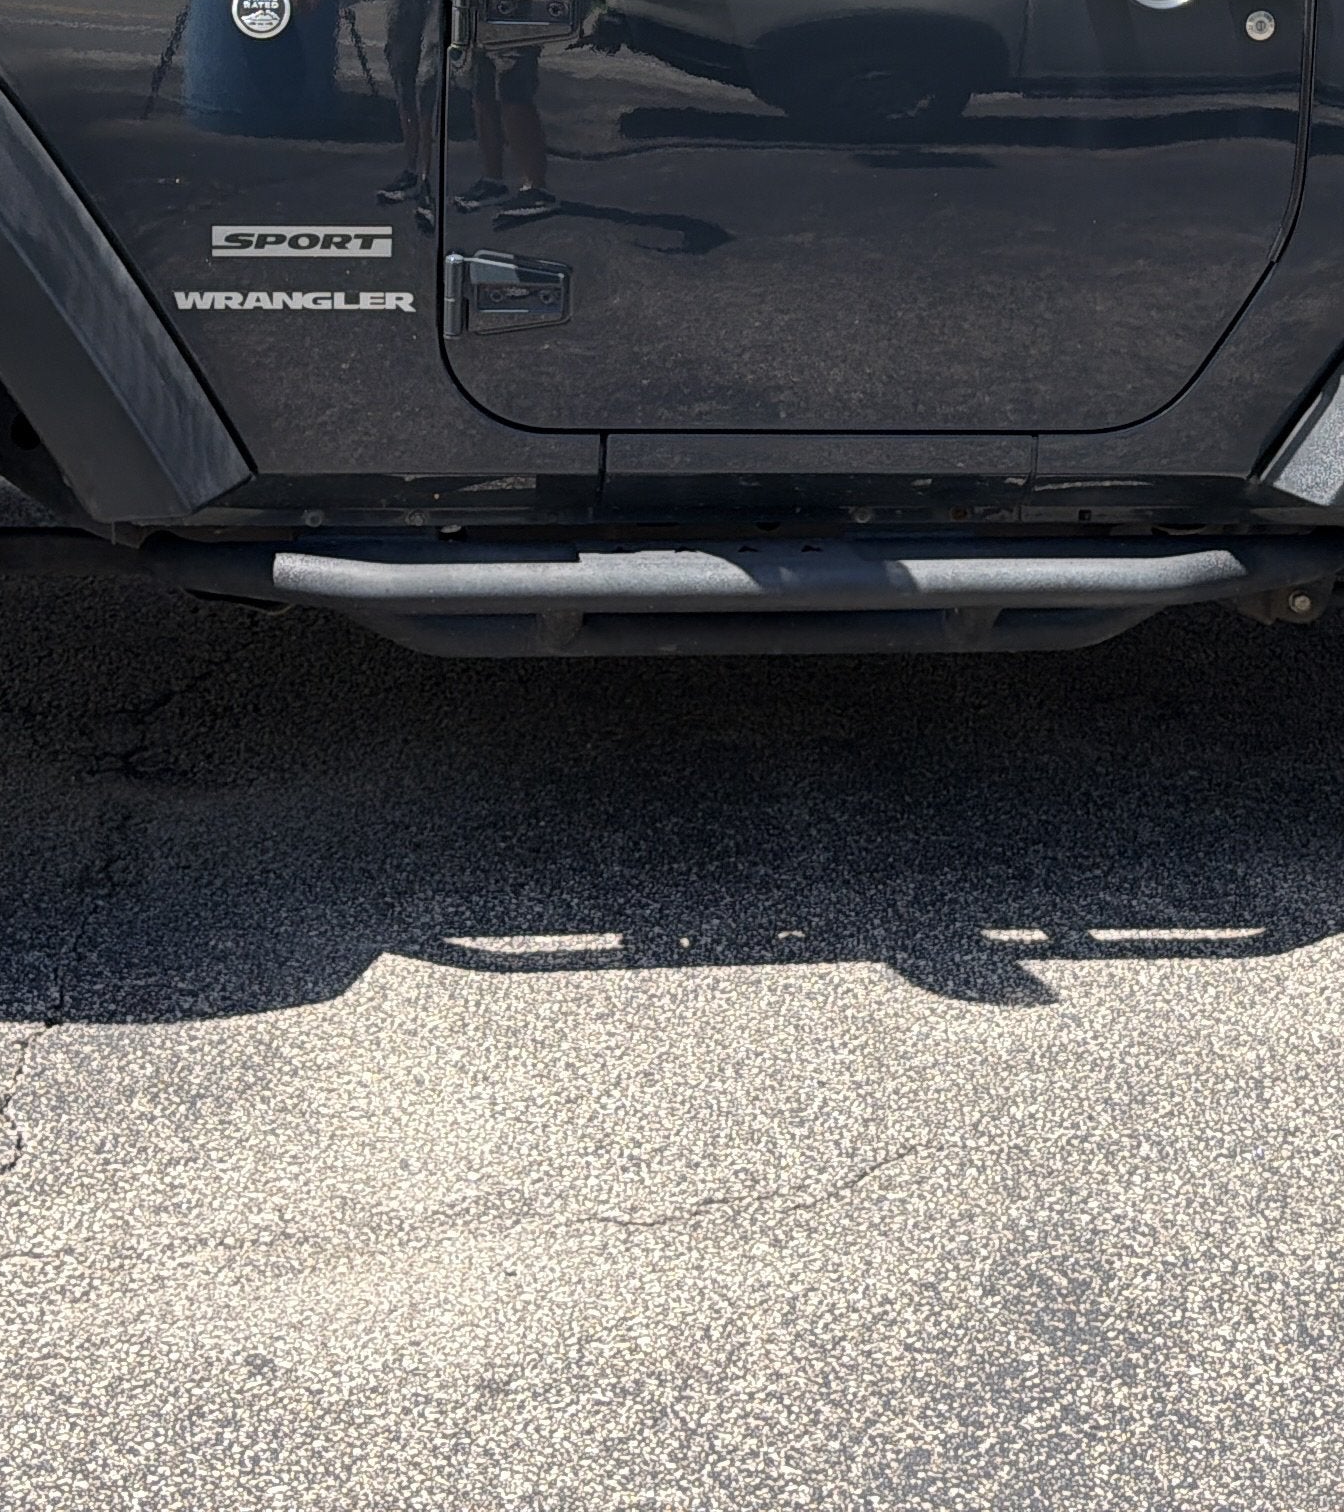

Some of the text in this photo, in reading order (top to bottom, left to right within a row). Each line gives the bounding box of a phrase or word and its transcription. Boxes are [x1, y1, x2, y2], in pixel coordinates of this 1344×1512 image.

[243, 0, 280, 9] RATED
[216, 231, 391, 251] SPORT
[173, 291, 417, 313] WRANGLER
